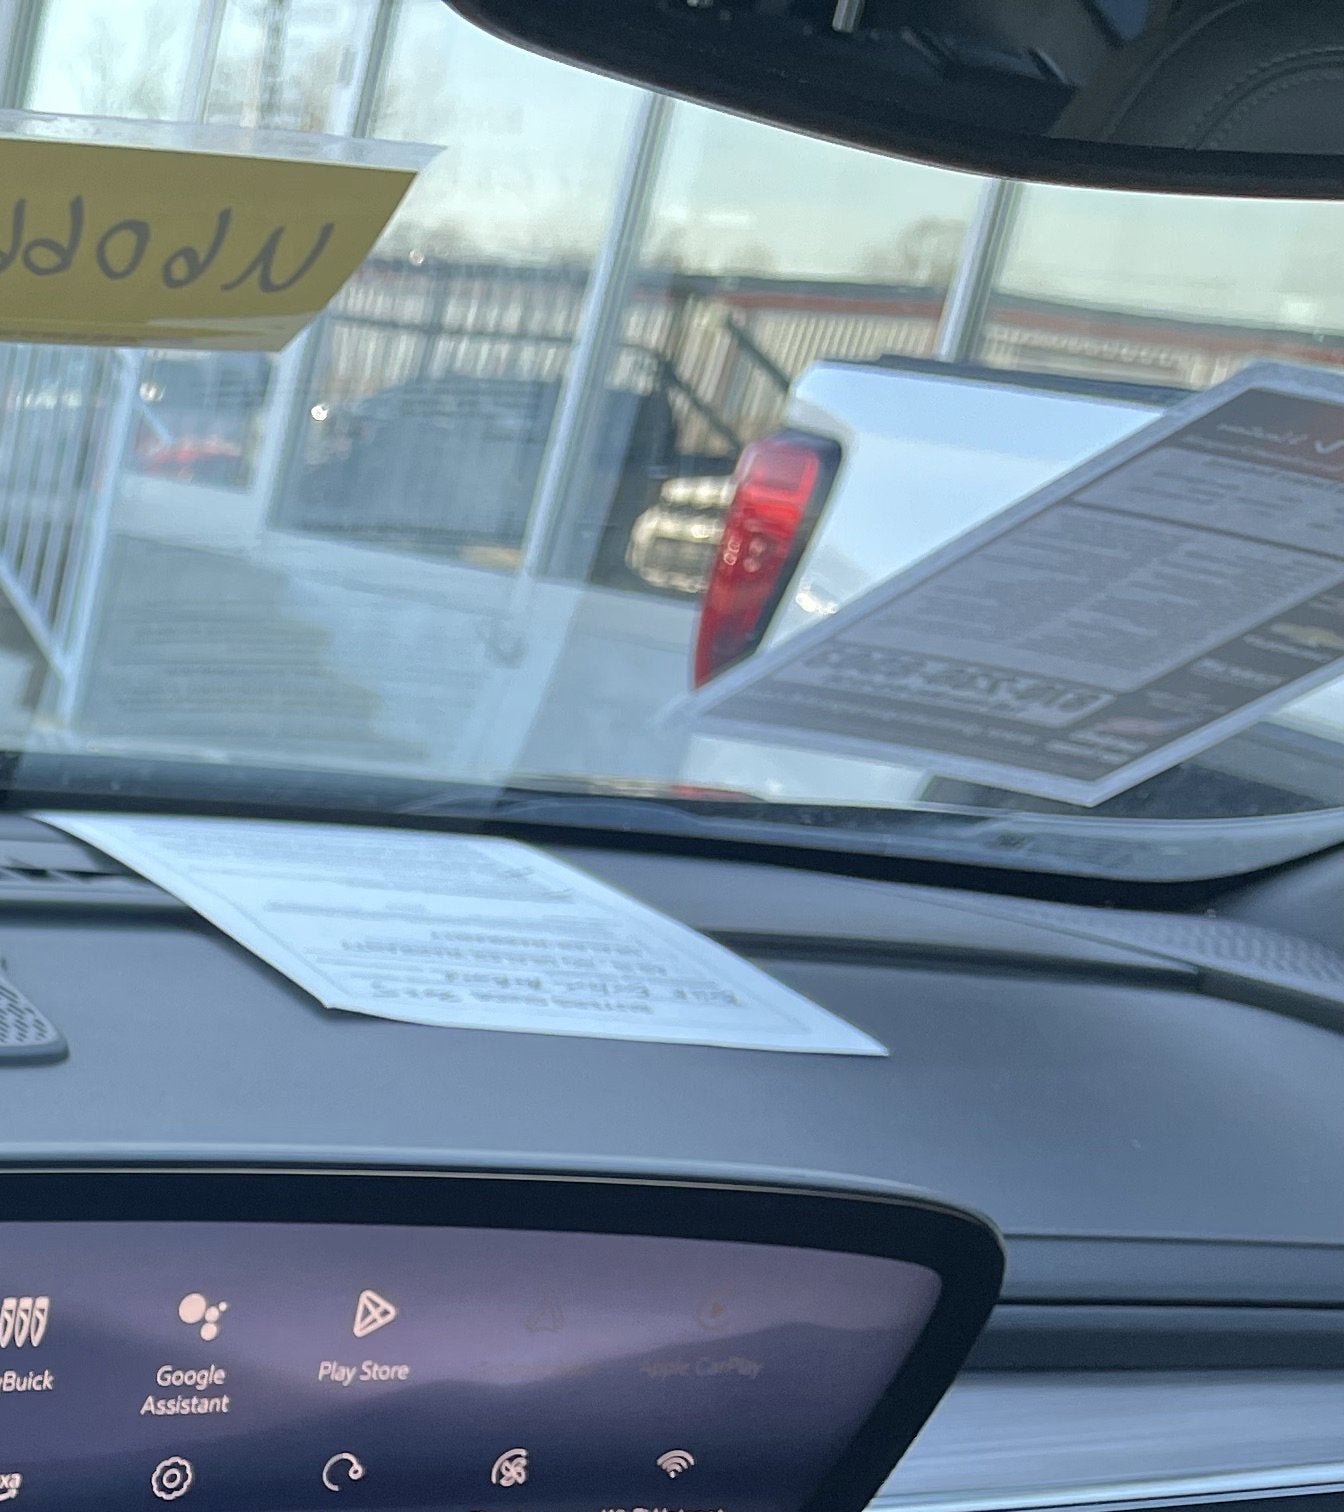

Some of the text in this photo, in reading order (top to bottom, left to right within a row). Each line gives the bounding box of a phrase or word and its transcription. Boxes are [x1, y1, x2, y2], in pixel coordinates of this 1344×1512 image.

[156, 1364, 226, 1391] Google
[318, 1360, 410, 1387] Play Store
[139, 1394, 230, 1416] Assistant
